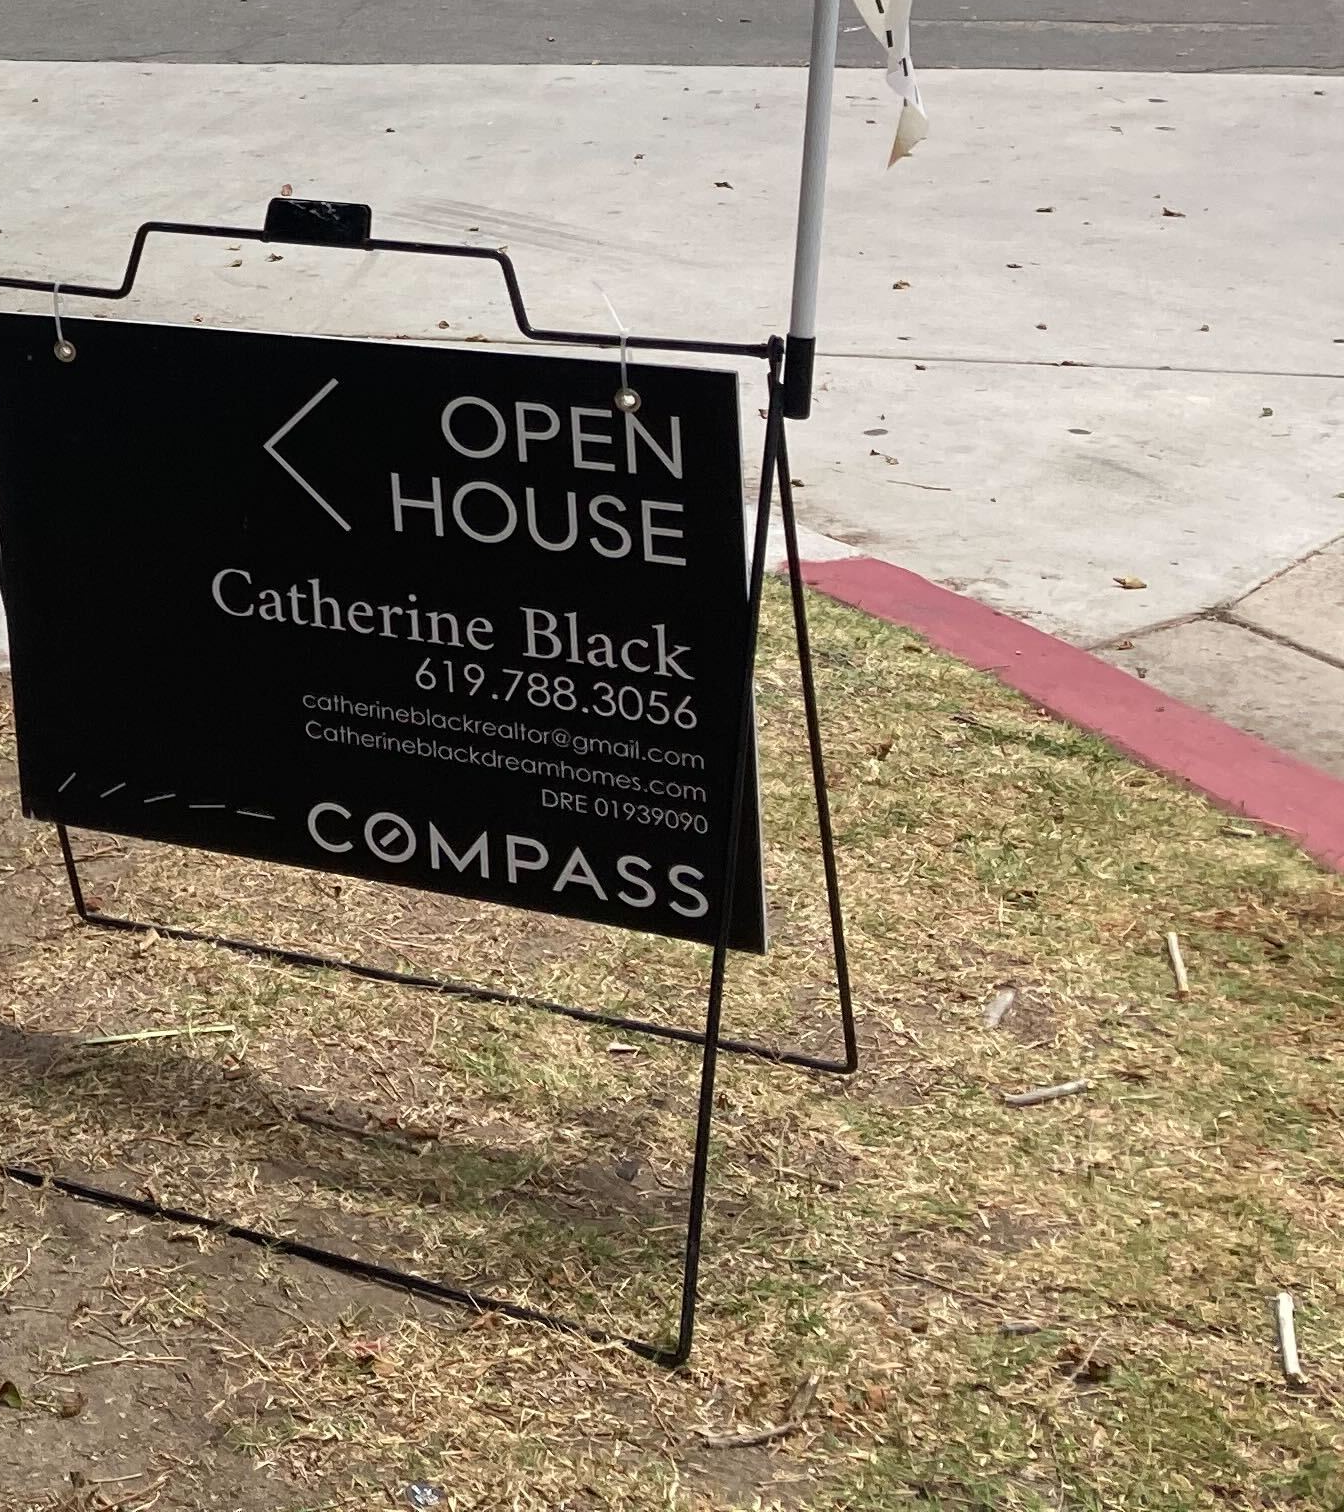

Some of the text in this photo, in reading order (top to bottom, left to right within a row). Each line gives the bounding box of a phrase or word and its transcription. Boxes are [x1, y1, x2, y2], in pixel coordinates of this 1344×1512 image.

[440, 395, 684, 480] OPEN
[390, 471, 688, 567] HOUSE
[210, 568, 696, 681] Catherine Black
[301, 693, 706, 771] catherineblackrealtor@gmail.com
[414, 657, 699, 730] 619.788.3056
[304, 719, 708, 804] Catherineblackdreamhomes.com
[540, 787, 709, 836] DRE 01939090
[306, 800, 712, 920] COMPASS
